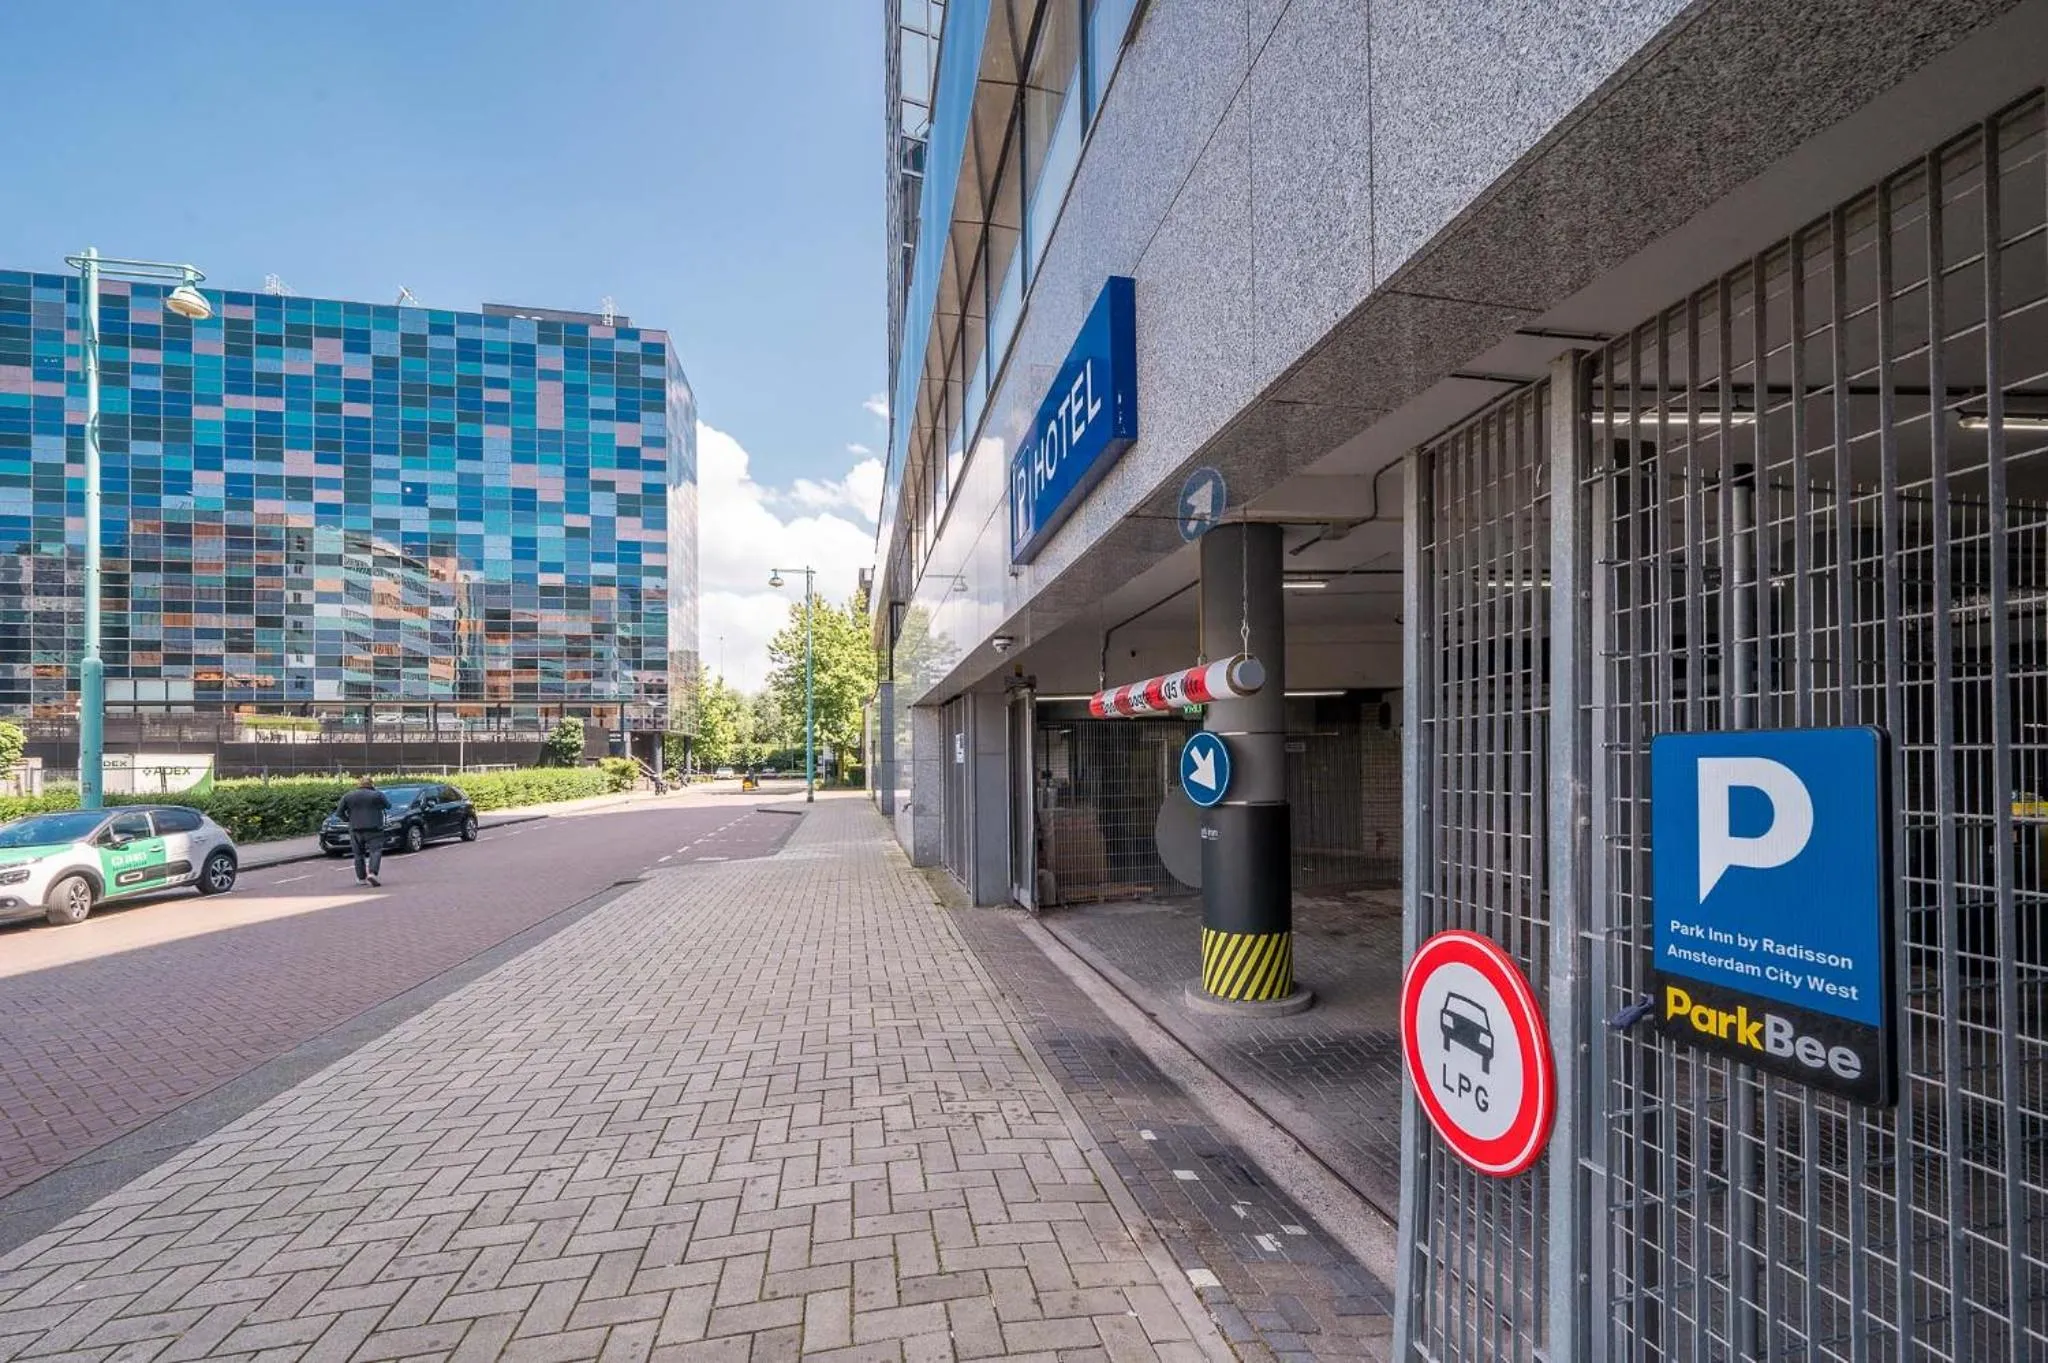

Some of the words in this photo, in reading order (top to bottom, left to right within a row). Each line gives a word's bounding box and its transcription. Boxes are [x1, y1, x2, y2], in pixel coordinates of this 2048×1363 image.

[1034, 358, 1101, 500] HOTEL
[153, 765, 192, 776] ADEX
[1697, 757, 1814, 904] P
[1667, 944, 1762, 978] Amsterdam
[1765, 966, 1803, 990] City
[1807, 974, 1860, 1001] West
[1670, 919, 1705, 939] Park
[1708, 927, 1734, 945] Inn
[1737, 933, 1758, 952] by
[1762, 938, 1854, 971] Radisson
[1666, 985, 1863, 1080] ParkBee
[1442, 1062, 1490, 1113] LPG
